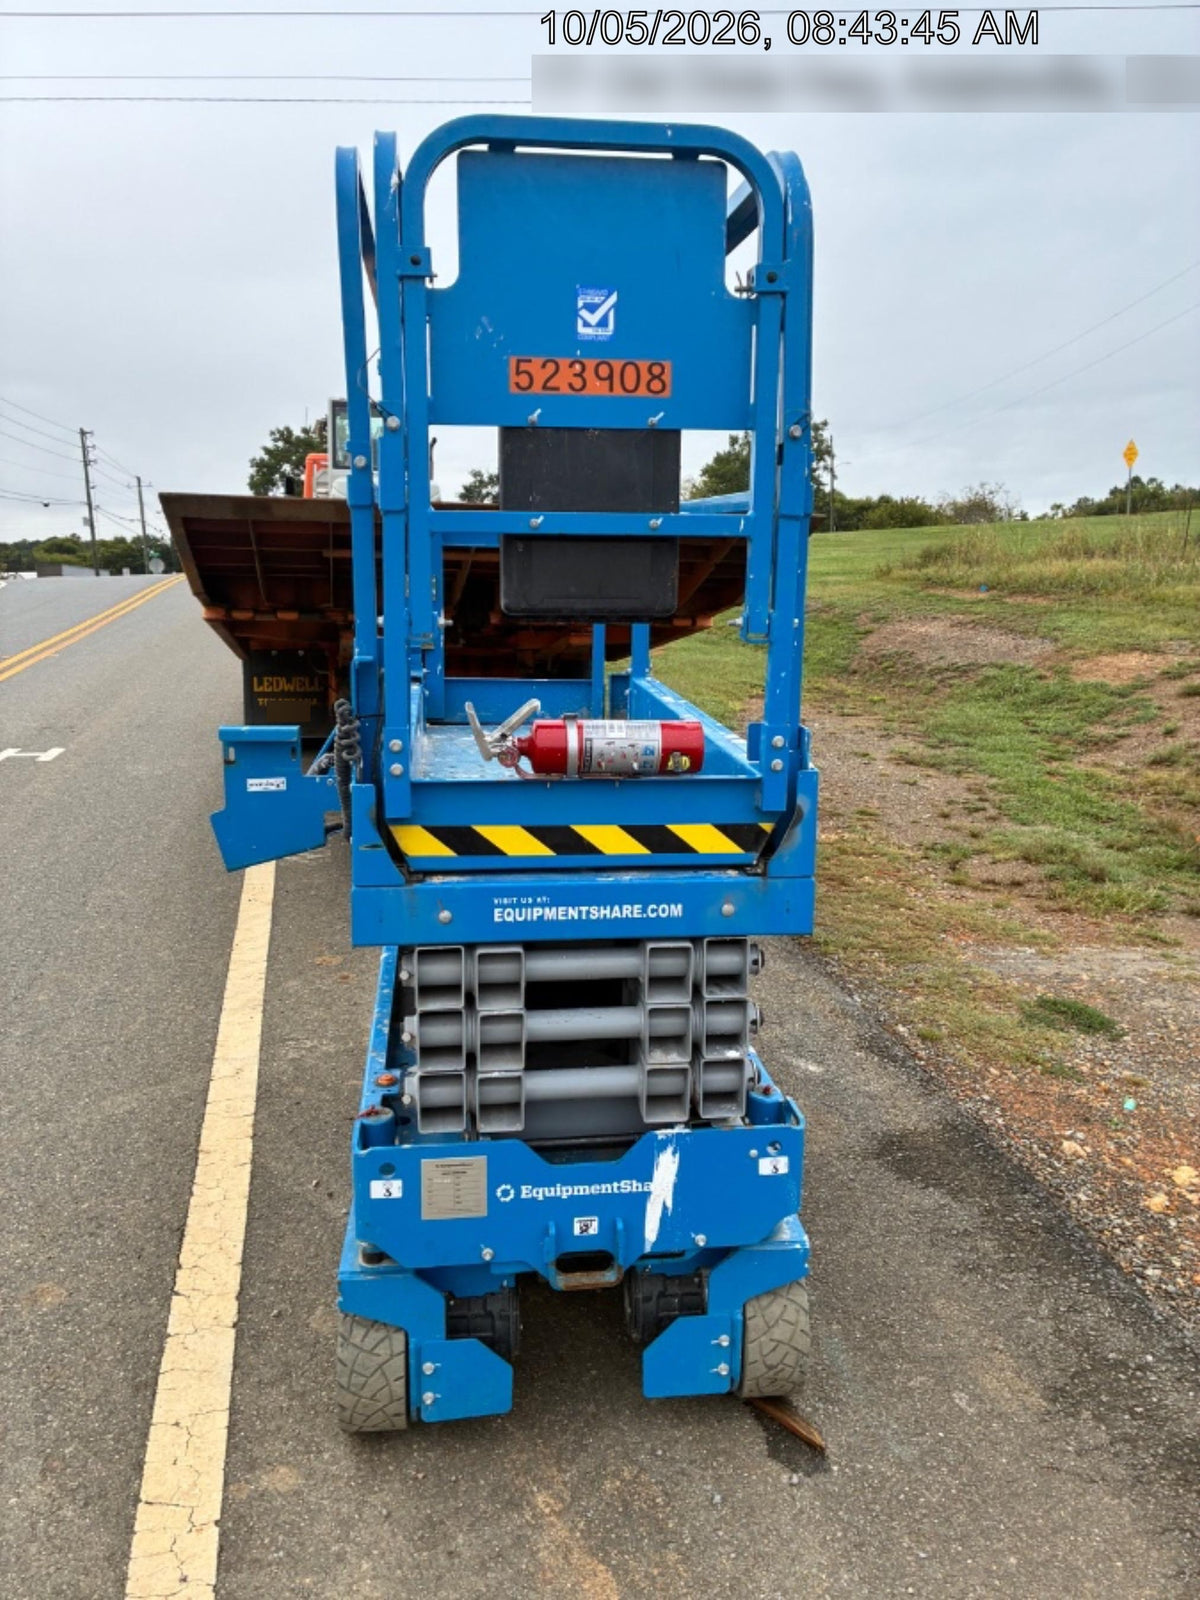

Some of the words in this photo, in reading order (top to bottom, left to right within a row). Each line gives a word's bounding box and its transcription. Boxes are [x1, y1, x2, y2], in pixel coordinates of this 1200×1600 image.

[513, 357, 667, 395] 523908
[252, 676, 323, 693] LEDWELL
[493, 897, 518, 905] VISIT
[493, 903, 684, 923] EQUIPMENTSHARE.COM
[520, 1179, 673, 1200] EquipmentSha
